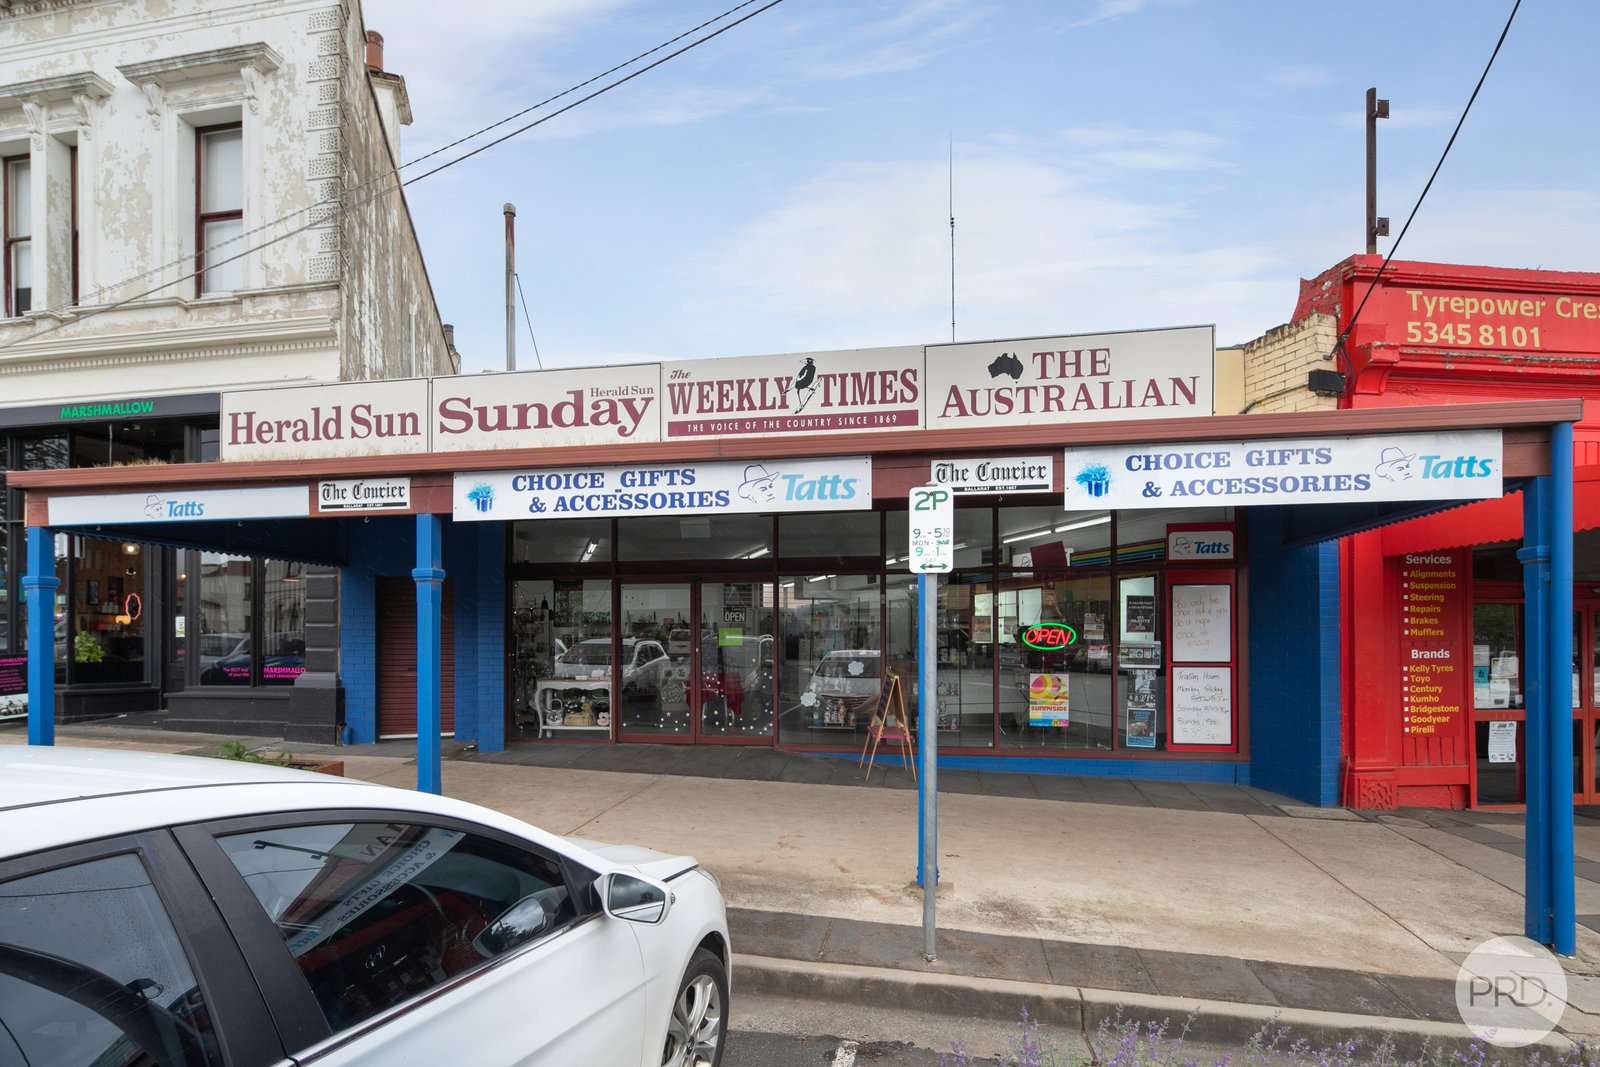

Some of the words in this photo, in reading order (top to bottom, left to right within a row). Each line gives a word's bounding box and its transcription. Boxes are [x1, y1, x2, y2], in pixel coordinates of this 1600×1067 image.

[1406, 290, 1546, 320] Tyrepower
[1407, 321, 1472, 345] 5345
[1478, 324, 1541, 348] 8101
[1032, 348, 1111, 380] THE
[670, 368, 691, 380] The
[590, 386, 629, 398] Herald
[631, 385, 654, 395] Sun
[667, 376, 793, 415] WEEKLY
[817, 368, 919, 407] TIMES
[937, 375, 1200, 418] AUSTRALIAN
[60, 401, 154, 419] MARSHMALLOW
[439, 389, 654, 438] Sunday
[228, 405, 344, 446] Herald
[350, 404, 421, 439] Sun
[688, 424, 704, 432] THE
[710, 422, 739, 432] VOICE
[745, 420, 757, 430] OF
[764, 420, 780, 429] THE
[786, 418, 832, 428] COUNTRY
[838, 416, 868, 425] SINCE
[874, 414, 898, 424] 1869
[1125, 452, 1231, 472] CHOICE
[1246, 448, 1332, 468] GIFTS
[1418, 455, 1493, 480] Tatts
[512, 472, 605, 492] CHOICE
[620, 468, 696, 488] GIFTS
[935, 462, 969, 484] The
[976, 461, 1047, 482] Courier
[322, 483, 347, 501] The
[352, 482, 406, 500] Courier
[781, 474, 858, 501] Tatts
[1142, 482, 1162, 498] &
[1170, 474, 1371, 497] ACCESSORIES
[166, 500, 204, 517] Tatts
[528, 497, 546, 513] &
[553, 490, 730, 512] ACCESSORIES
[914, 490, 948, 510] 2P
[912, 528, 921, 538] 9
[934, 528, 942, 538] 5
[916, 546, 924, 556] 9
[1194, 542, 1230, 554] Tatts
[1406, 554, 1452, 564] Services
[1410, 570, 1456, 579] Alignments
[1410, 582, 1456, 590] Suspension
[1410, 594, 1444, 602] Steering
[725, 612, 745, 622] OPEN
[1410, 605, 1441, 614] Repairs
[1410, 616, 1438, 624] Brakes
[1026, 628, 1072, 646] OPEN
[1410, 628, 1444, 636] Mufflers
[1412, 648, 1450, 659] Brands
[1410, 664, 1430, 673] Kelly
[1431, 664, 1454, 674] Tyres
[1410, 675, 1430, 684] Toyo
[1410, 706, 1460, 714] Bridgestone
[1410, 715, 1450, 724] Goodyear
[1411, 726, 1435, 734] Pirelli
